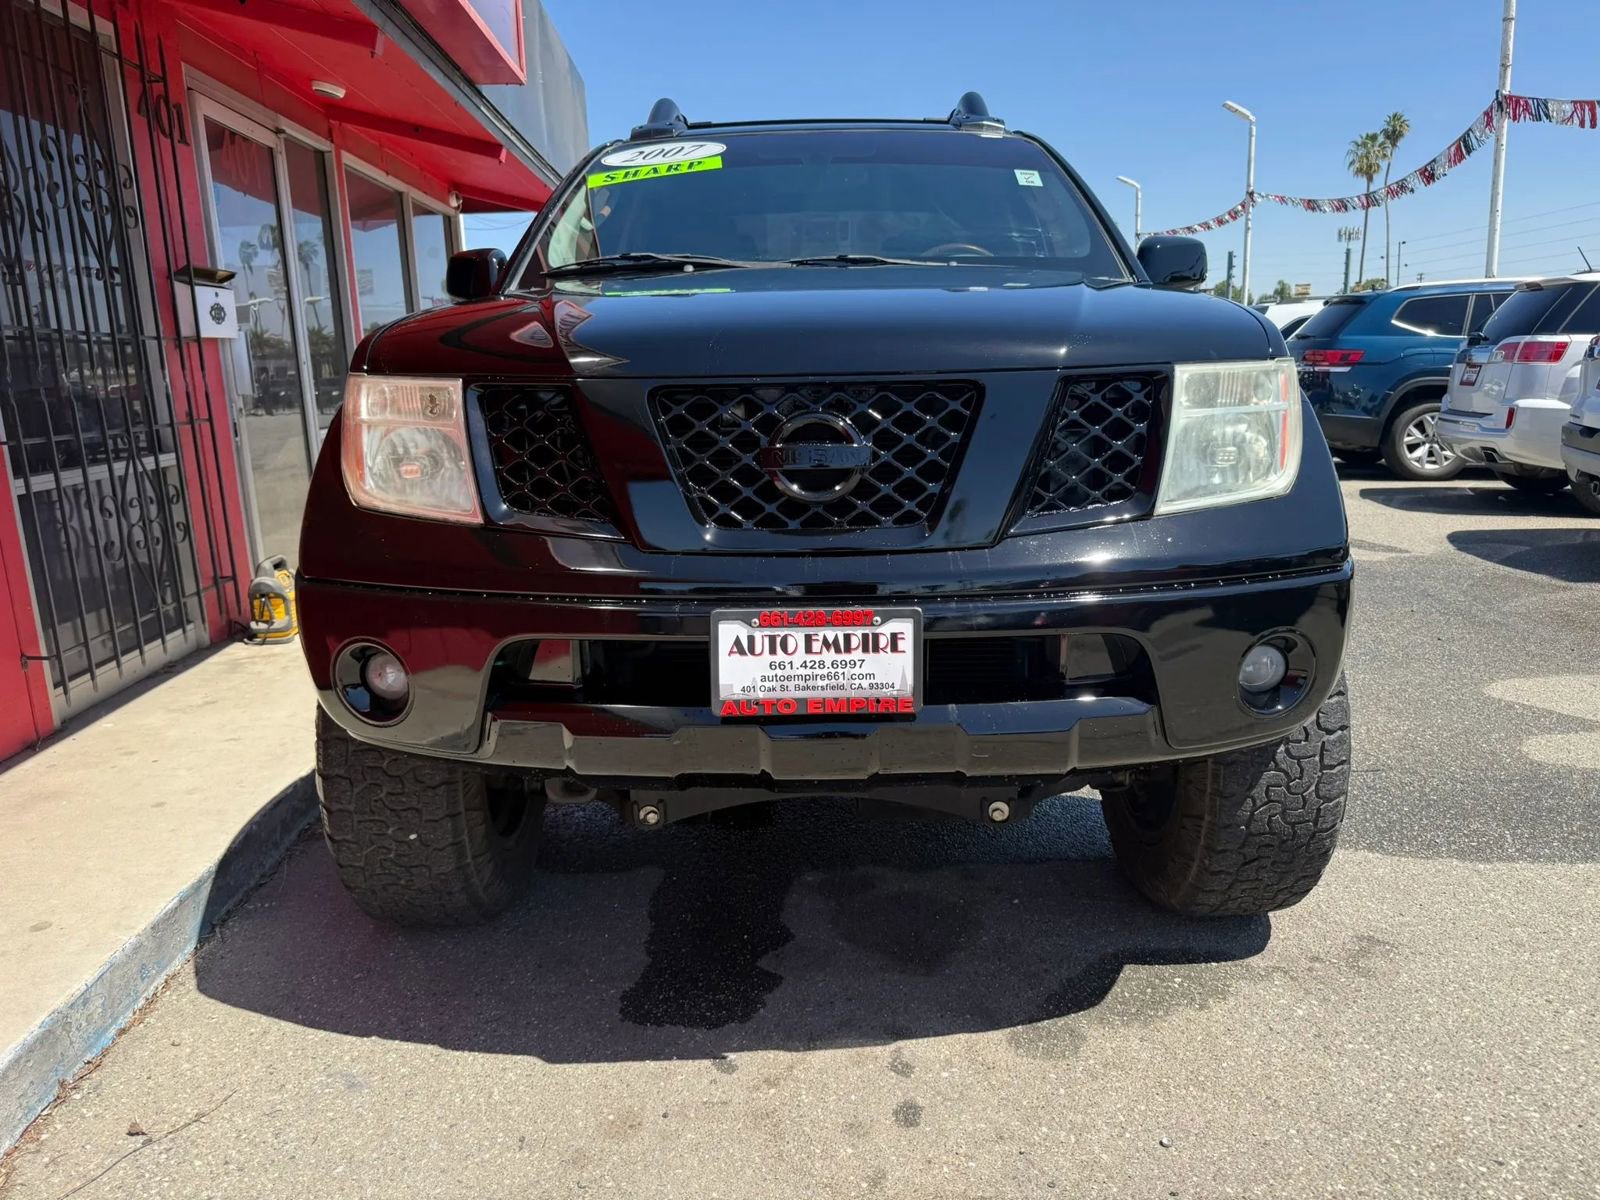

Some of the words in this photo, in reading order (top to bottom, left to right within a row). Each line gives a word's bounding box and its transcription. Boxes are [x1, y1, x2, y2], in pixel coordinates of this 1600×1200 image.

[622, 144, 704, 163] 2007
[603, 160, 704, 183] SHARP
[759, 609, 873, 627] 661-428-6997
[728, 634, 798, 656] AUTO
[804, 632, 906, 654] EMPIRE
[769, 659, 866, 670] 661.428.6997
[760, 672, 875, 684] autoempire661.com
[740, 685, 757, 694] 401
[759, 684, 777, 693] Oak
[780, 684, 792, 692] St.
[868, 681, 895, 690] 93304
[720, 699, 797, 716] AUTO
[807, 698, 914, 714] EMPIRE
